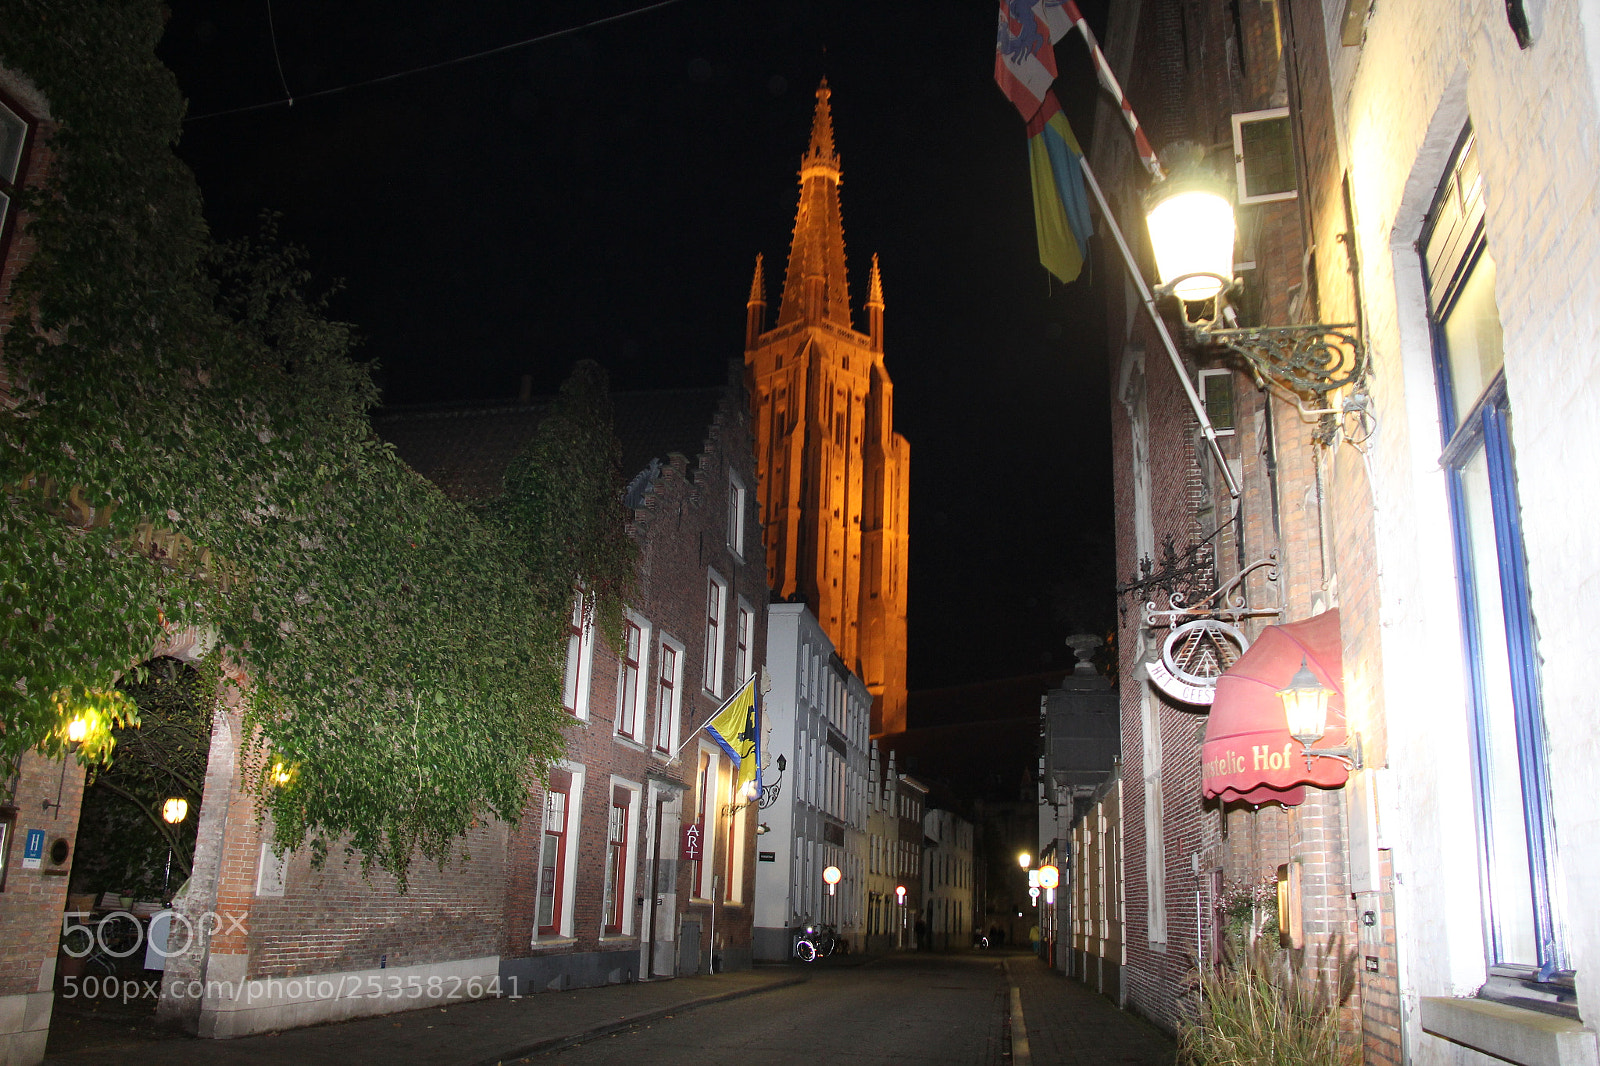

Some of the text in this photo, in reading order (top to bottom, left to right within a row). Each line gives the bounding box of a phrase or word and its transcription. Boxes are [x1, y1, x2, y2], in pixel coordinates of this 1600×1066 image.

[1151, 665, 1174, 688] HET
[1252, 743, 1292, 771] Hof
[30, 833, 40, 851] H
